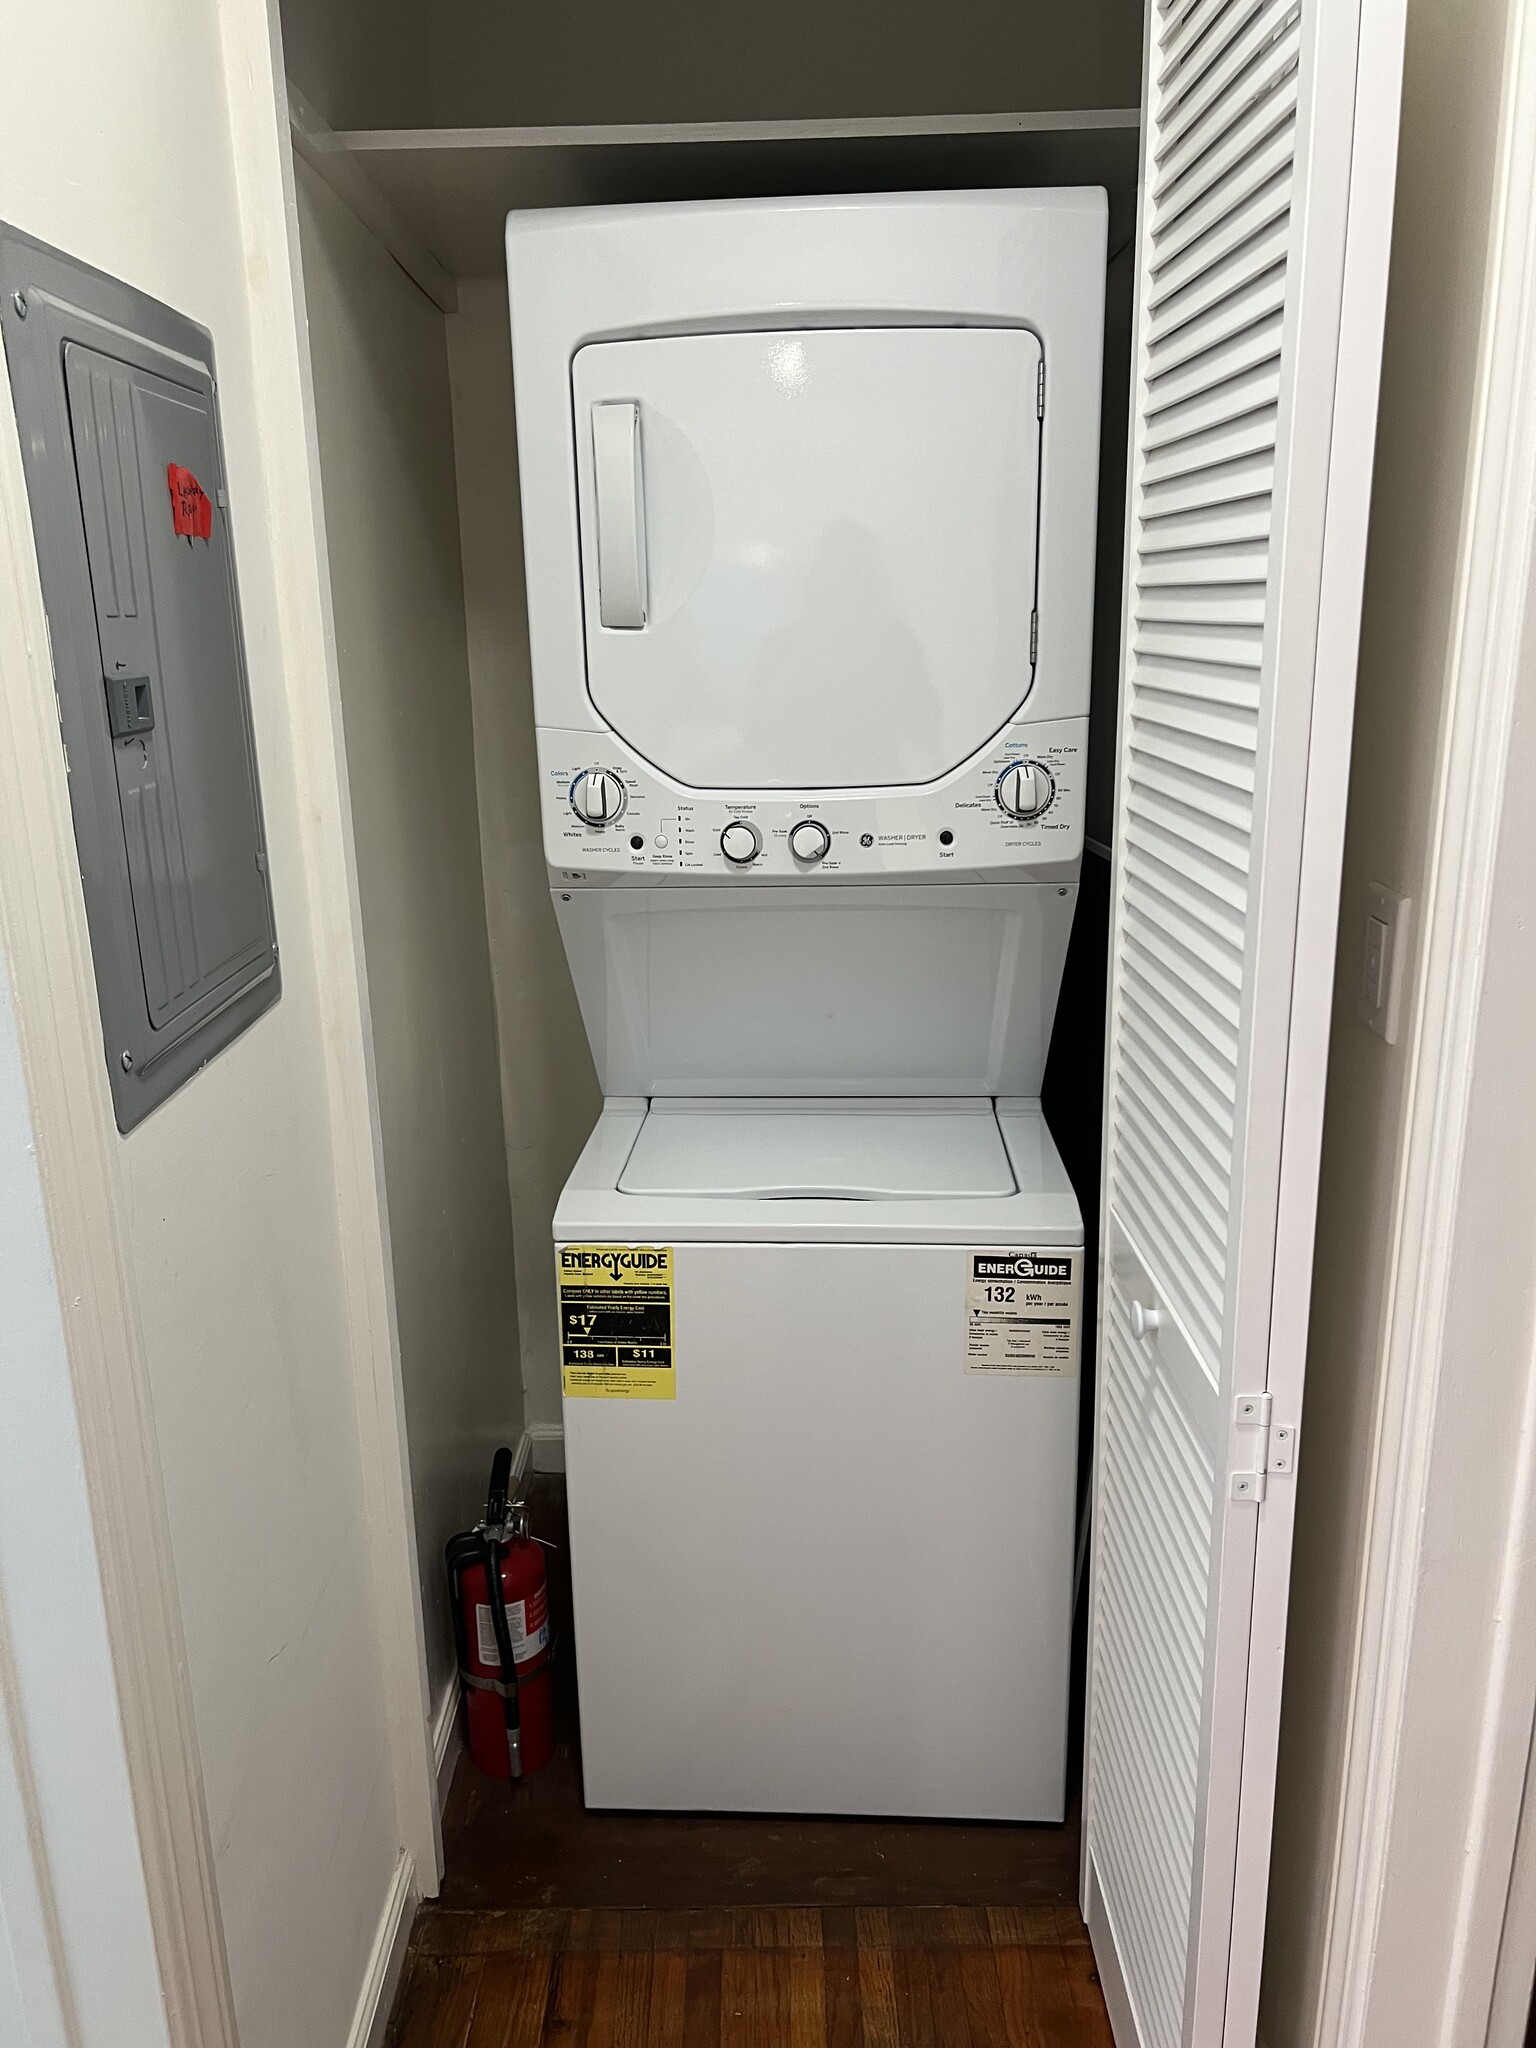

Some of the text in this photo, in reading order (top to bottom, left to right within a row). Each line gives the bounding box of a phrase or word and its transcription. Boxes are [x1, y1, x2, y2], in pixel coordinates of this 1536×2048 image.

[562, 1253, 667, 1269] ENERGYGUIDE
[978, 1259, 1067, 1277] ENERGUIDE
[984, 1286, 1015, 1302] 132
[569, 1314, 597, 1326] $17
[574, 1350, 594, 1358] 138
[633, 1349, 655, 1358] $11
